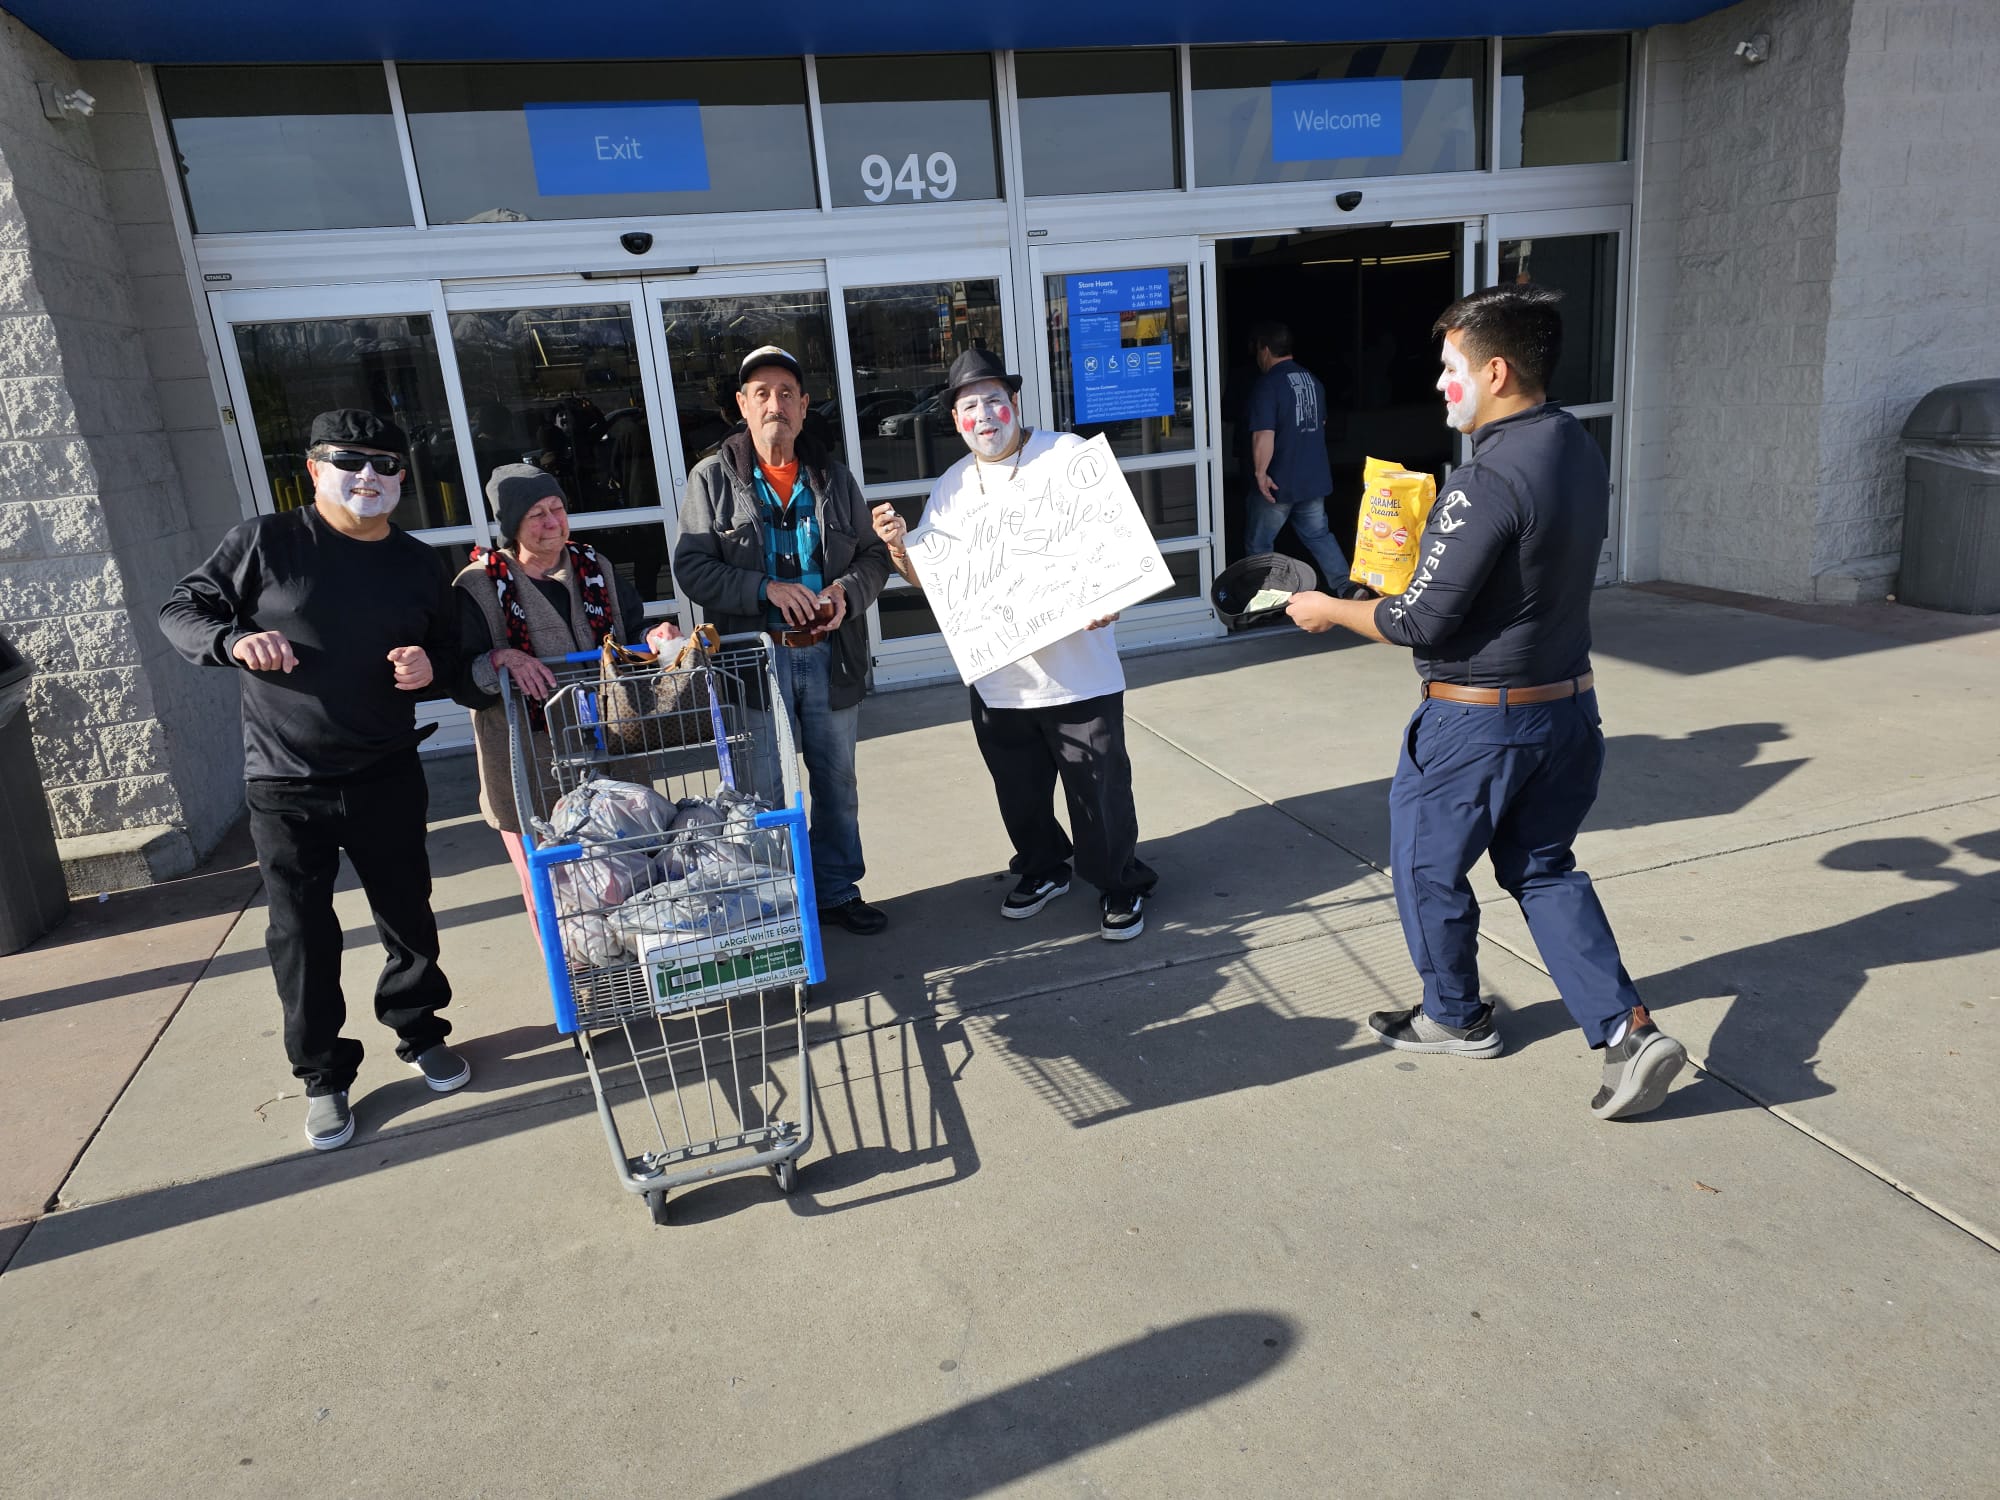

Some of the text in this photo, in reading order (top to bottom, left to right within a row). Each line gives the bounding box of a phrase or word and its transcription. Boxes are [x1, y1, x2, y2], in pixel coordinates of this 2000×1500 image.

[1293, 109, 1382, 132] Welcome
[594, 135, 643, 160] Exit
[860, 151, 957, 203] 949
[1370, 495, 1402, 509] CARAMEL
[1371, 505, 1400, 517] Creams
[948, 541, 1011, 610] Child
[970, 642, 994, 668] SAY
[720, 936, 749, 949] LARGE
